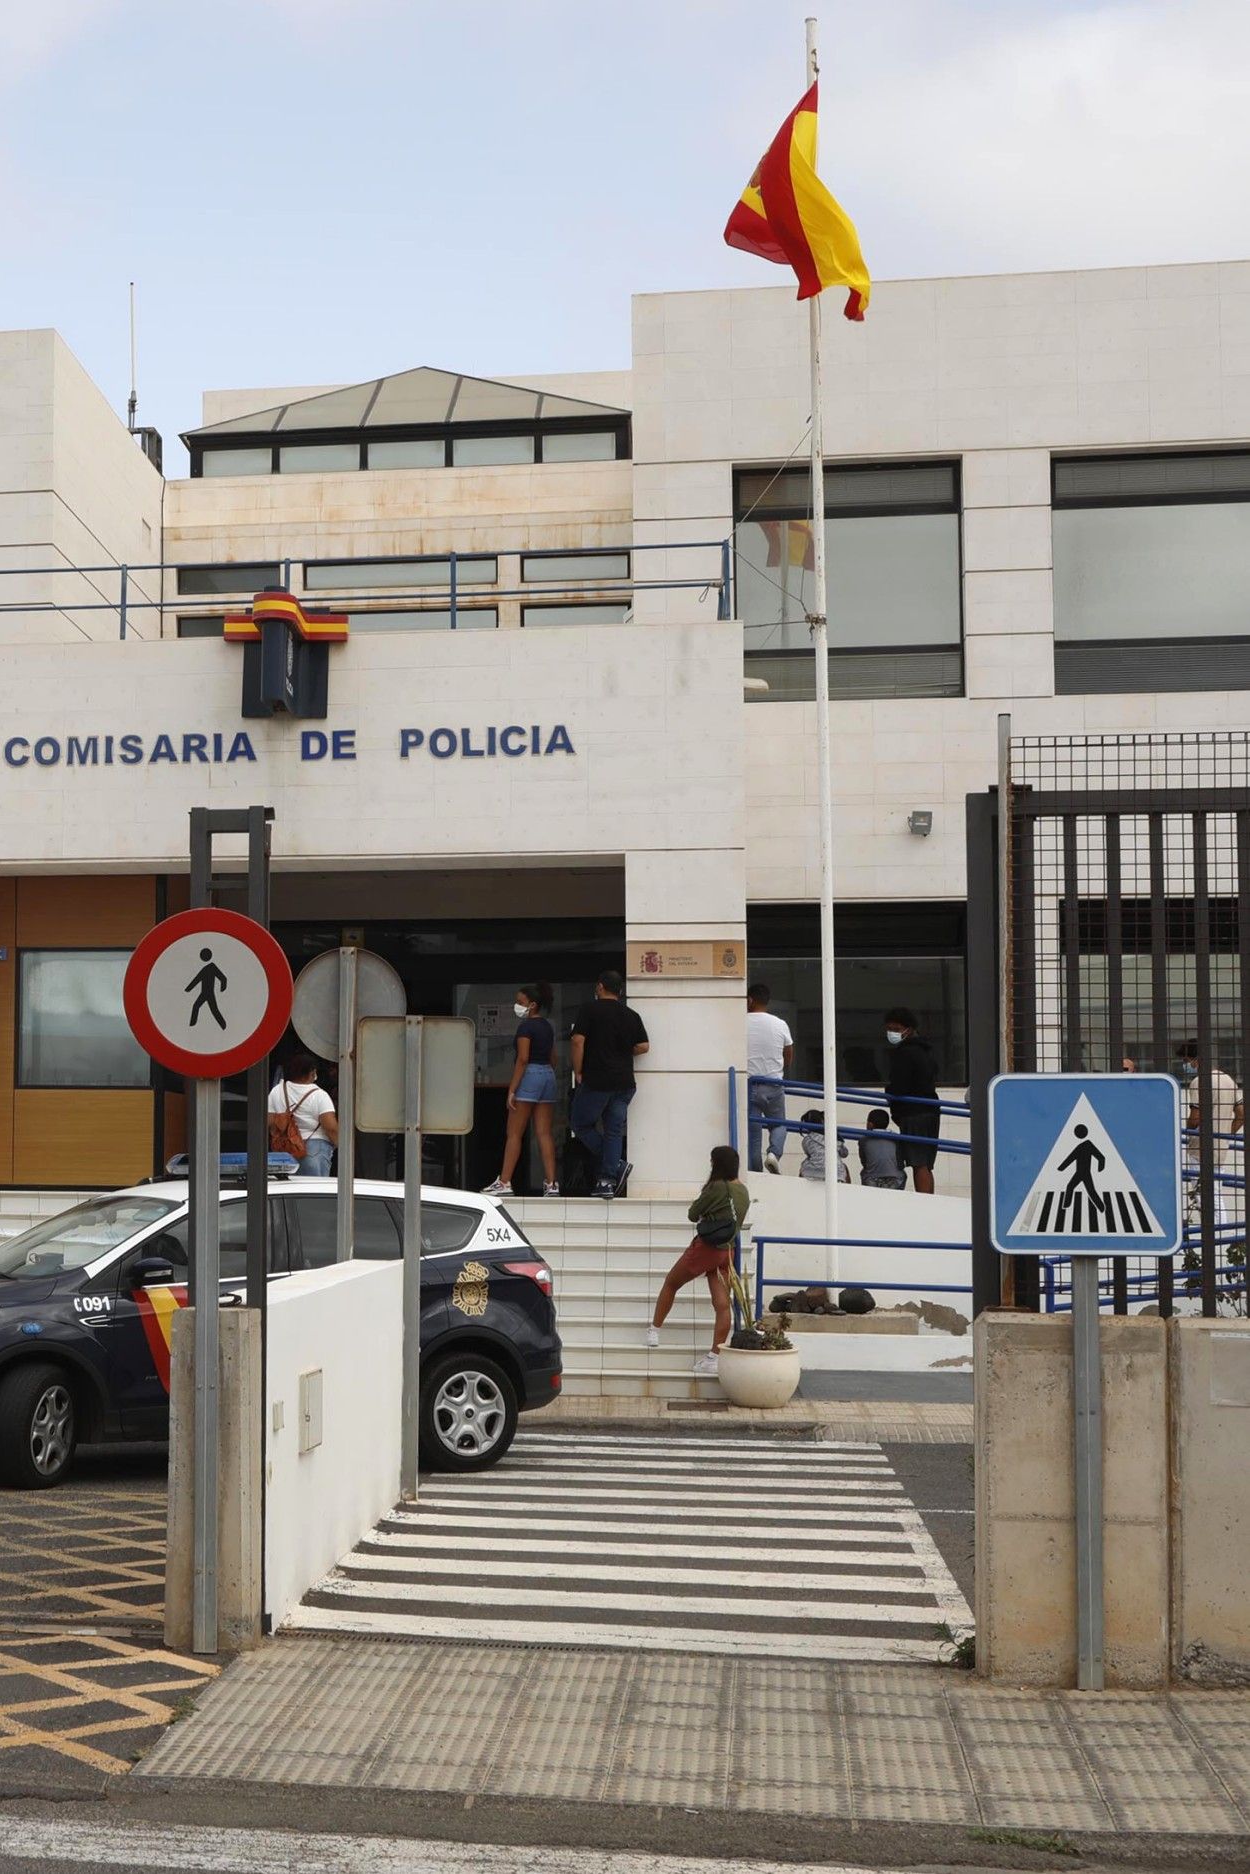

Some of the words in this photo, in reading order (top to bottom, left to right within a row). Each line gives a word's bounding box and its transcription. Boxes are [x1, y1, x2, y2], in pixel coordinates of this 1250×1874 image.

[3, 731, 257, 767] COMISARIA
[300, 729, 356, 762] DE
[400, 724, 575, 759] POLICIA
[486, 1228, 511, 1242] 5X4
[82, 1296, 111, 1312] 091
